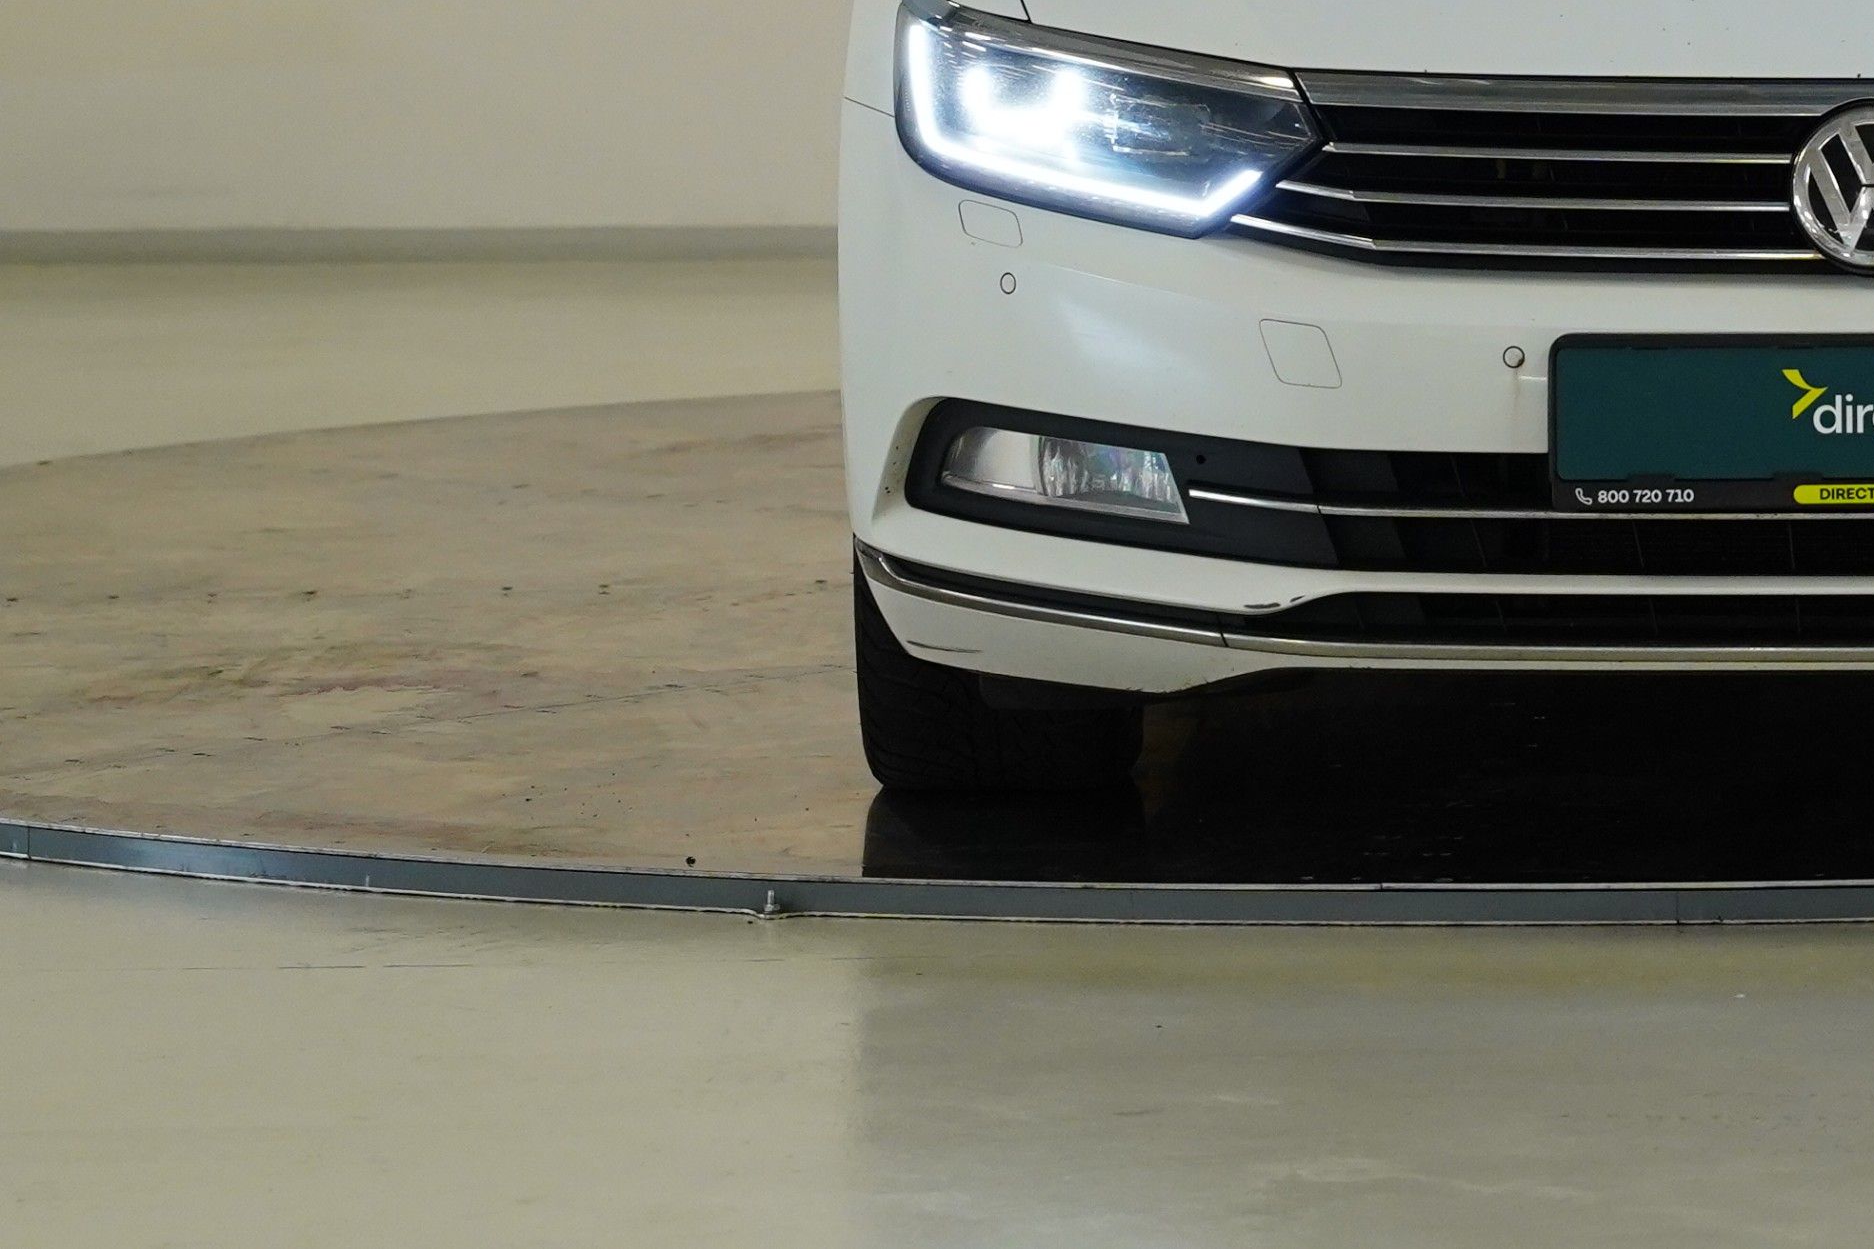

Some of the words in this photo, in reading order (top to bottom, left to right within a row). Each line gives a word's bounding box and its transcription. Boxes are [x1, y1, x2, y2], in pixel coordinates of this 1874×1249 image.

[1598, 489, 1630, 503] 800
[1633, 489, 1662, 503] 720
[1666, 488, 1695, 503] 710
